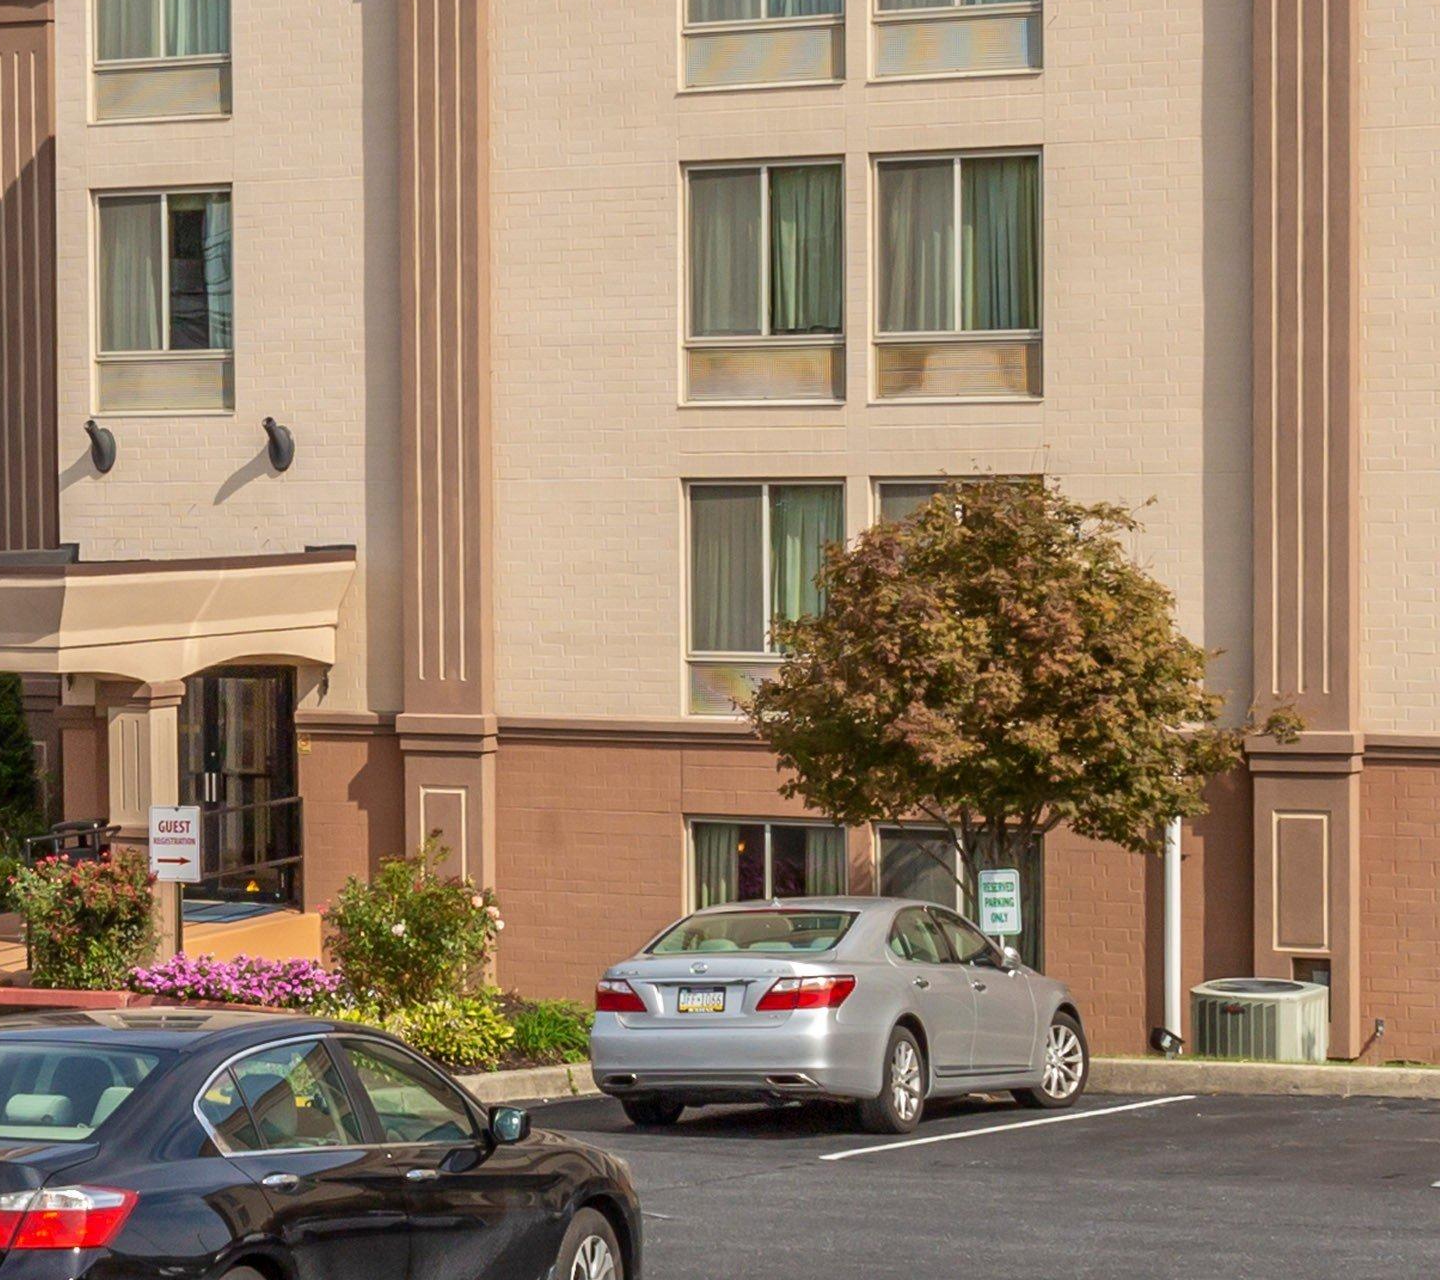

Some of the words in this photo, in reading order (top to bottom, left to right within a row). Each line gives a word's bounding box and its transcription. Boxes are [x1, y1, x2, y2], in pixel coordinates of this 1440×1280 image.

[158, 820, 191, 834] GUEST
[982, 882, 1015, 893] RESERVED
[985, 897, 1015, 908] PARKING
[991, 912, 1008, 923] ONLY
